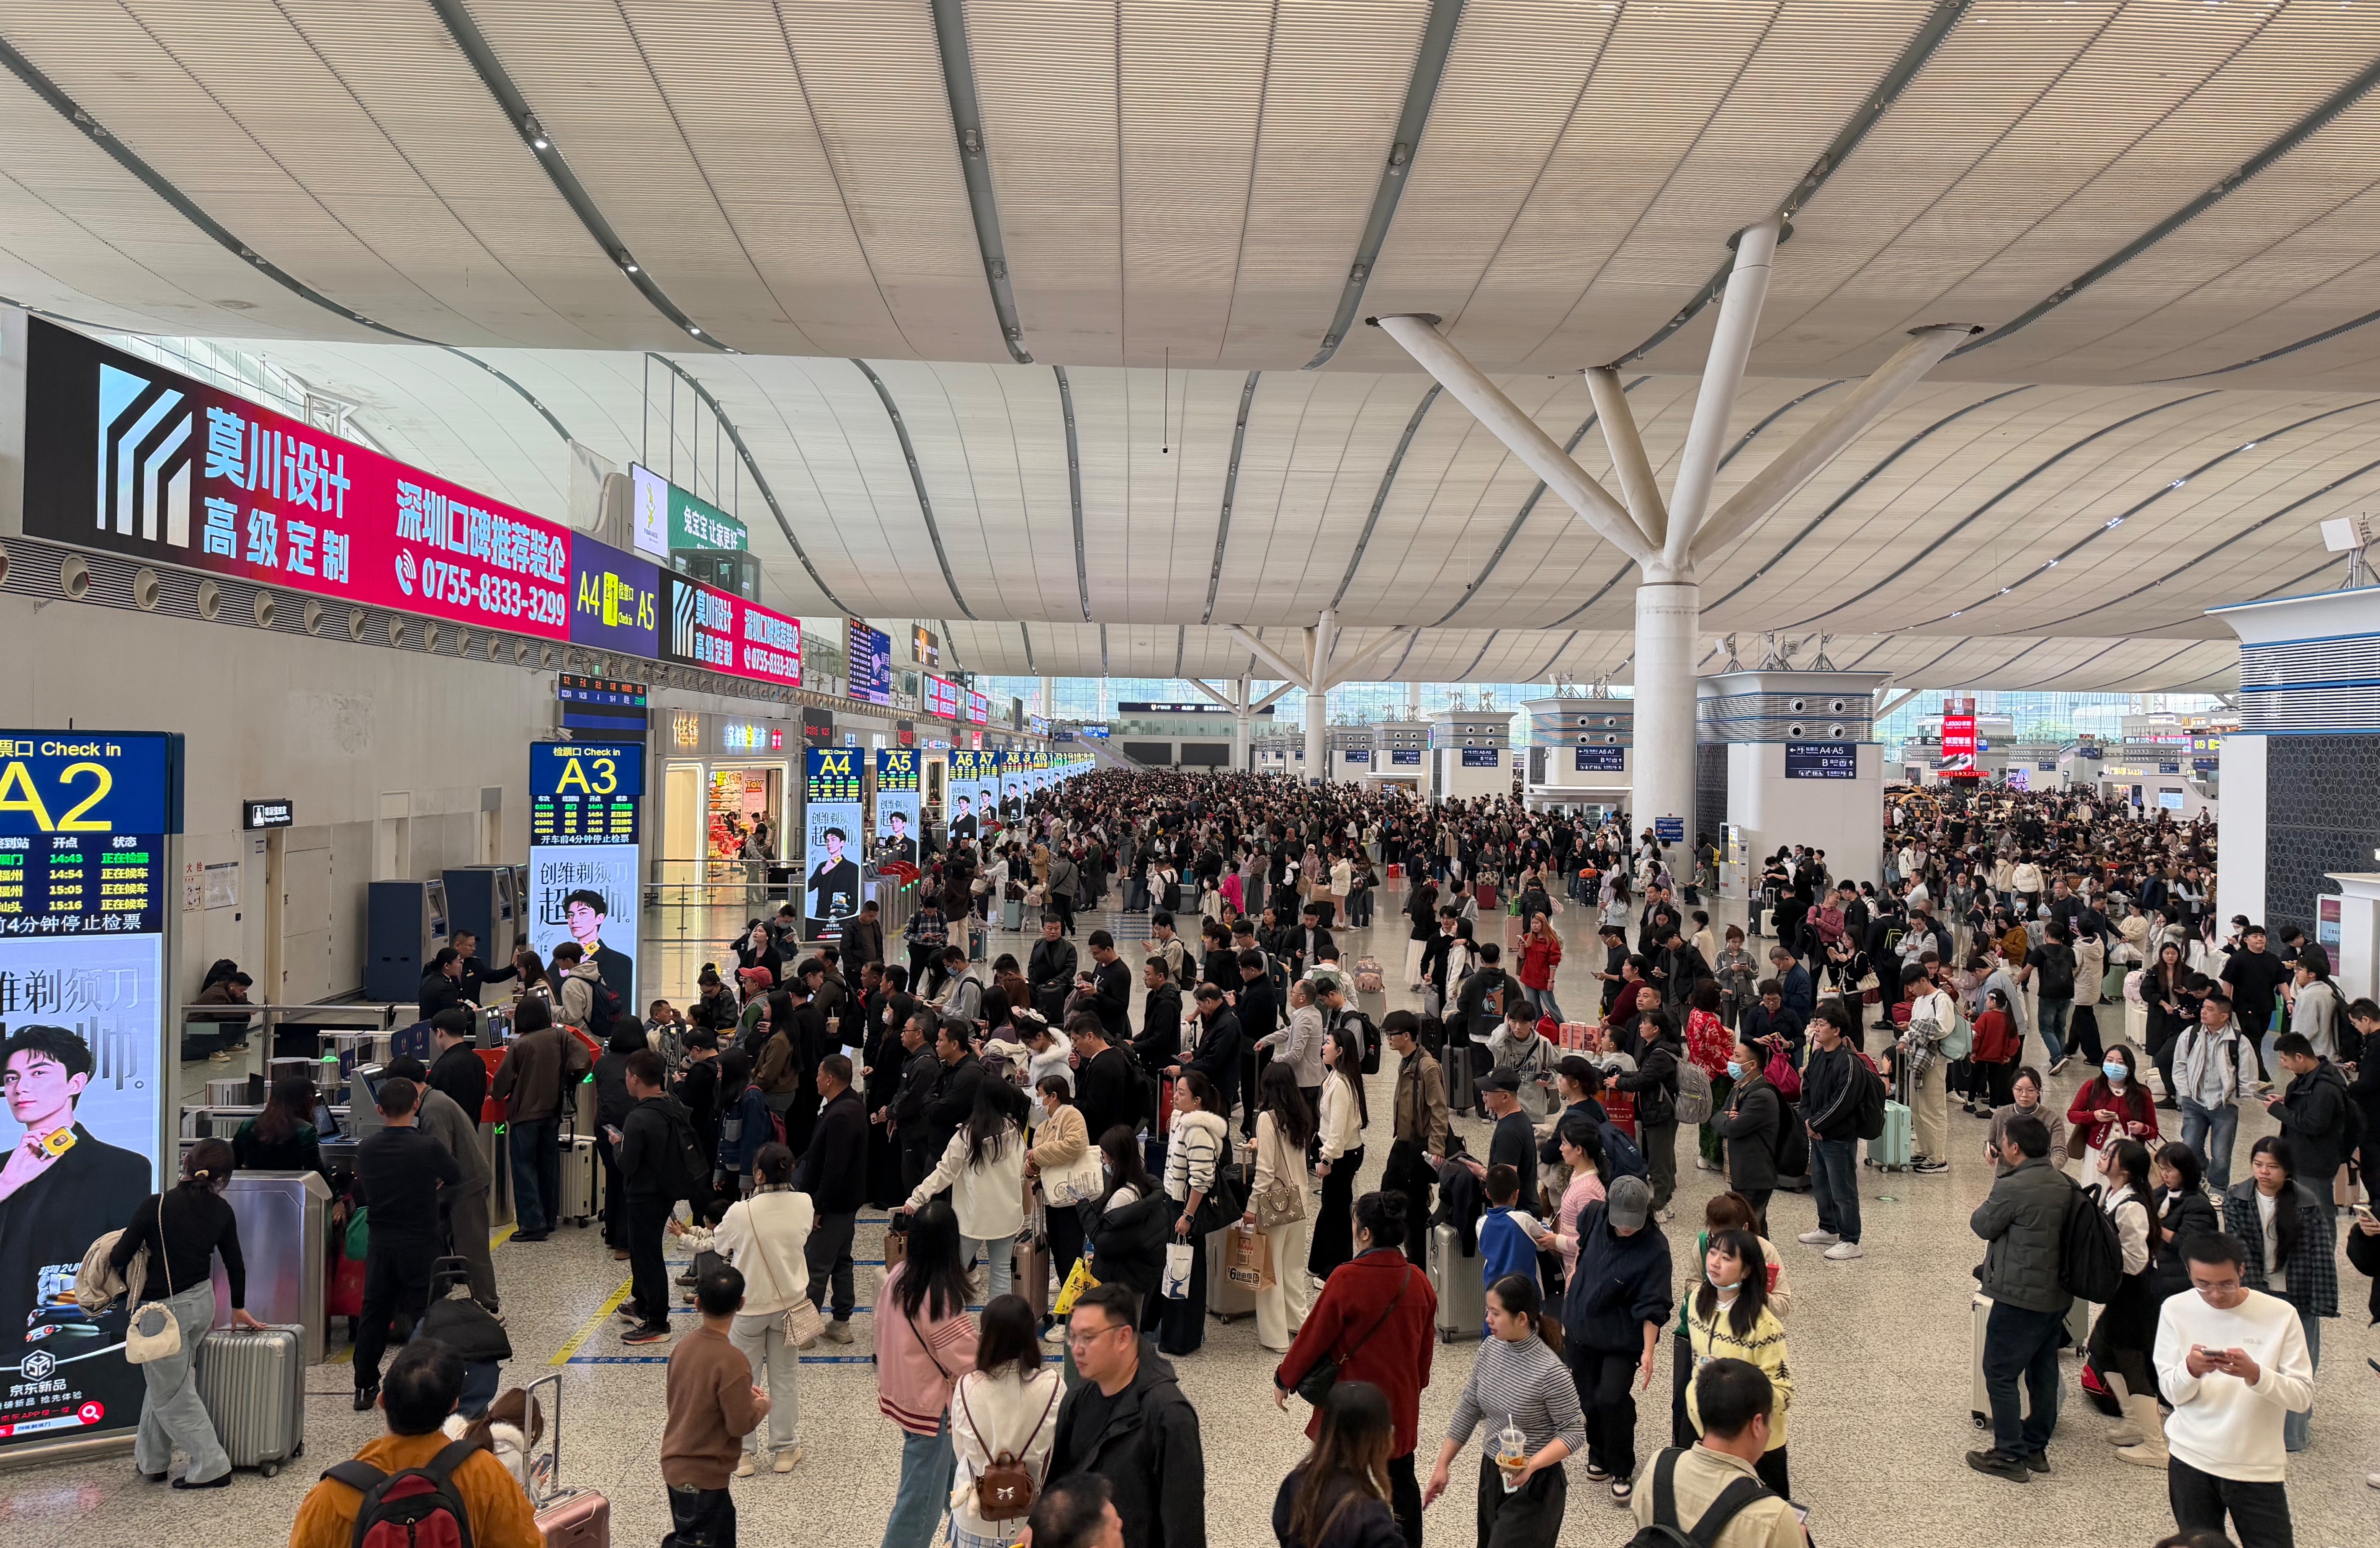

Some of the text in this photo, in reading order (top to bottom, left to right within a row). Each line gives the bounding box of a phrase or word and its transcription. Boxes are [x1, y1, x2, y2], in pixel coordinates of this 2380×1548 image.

[205, 406, 350, 519] 莫川设计
[396, 478, 566, 585] 深圳口碑推荐装企
[684, 505, 738, 550] 兔宝宝 让家更好
[204, 496, 349, 584] 高级定制
[422, 557, 566, 627] 0755-8333-3299
[577, 571, 600, 616] A4
[618, 582, 634, 602] 检票口
[637, 591, 654, 631] A5
[695, 589, 733, 635] 莫川设计
[744, 607, 799, 654] 深圳口碑推荐装企
[695, 631, 733, 667] 高级定制
[751, 647, 798, 679] 0755-8333-3299
[41, 742, 100, 756] Check
[106, 743, 121, 756] in
[553, 747, 581, 756] 检票口
[979, 754, 994, 764] A7
[1007, 754, 1020, 763] A8
[819, 755, 851, 775] A4
[886, 755, 912, 771] A5
[956, 754, 974, 766] A6
[555, 758, 617, 794] A3
[745, 779, 764, 789] TOY
[0, 761, 112, 831] A2
[0, 836, 137, 849] 到站 开点 状态
[541, 834, 629, 844] 开车前4分钟停止检票
[50, 854, 83, 864] 14:43
[101, 853, 149, 864] 正在检票
[0, 868, 148, 881] 福州 14:54 正在候车
[540, 861, 628, 885] 创维剃须刀
[0, 883, 148, 897] 福州 15:05 正在候车
[49, 900, 82, 910] 15:16
[100, 898, 148, 910] 正在候车
[10, 1378, 67, 1397] 京东新品
[40, 1391, 82, 1404] 抢先体验
